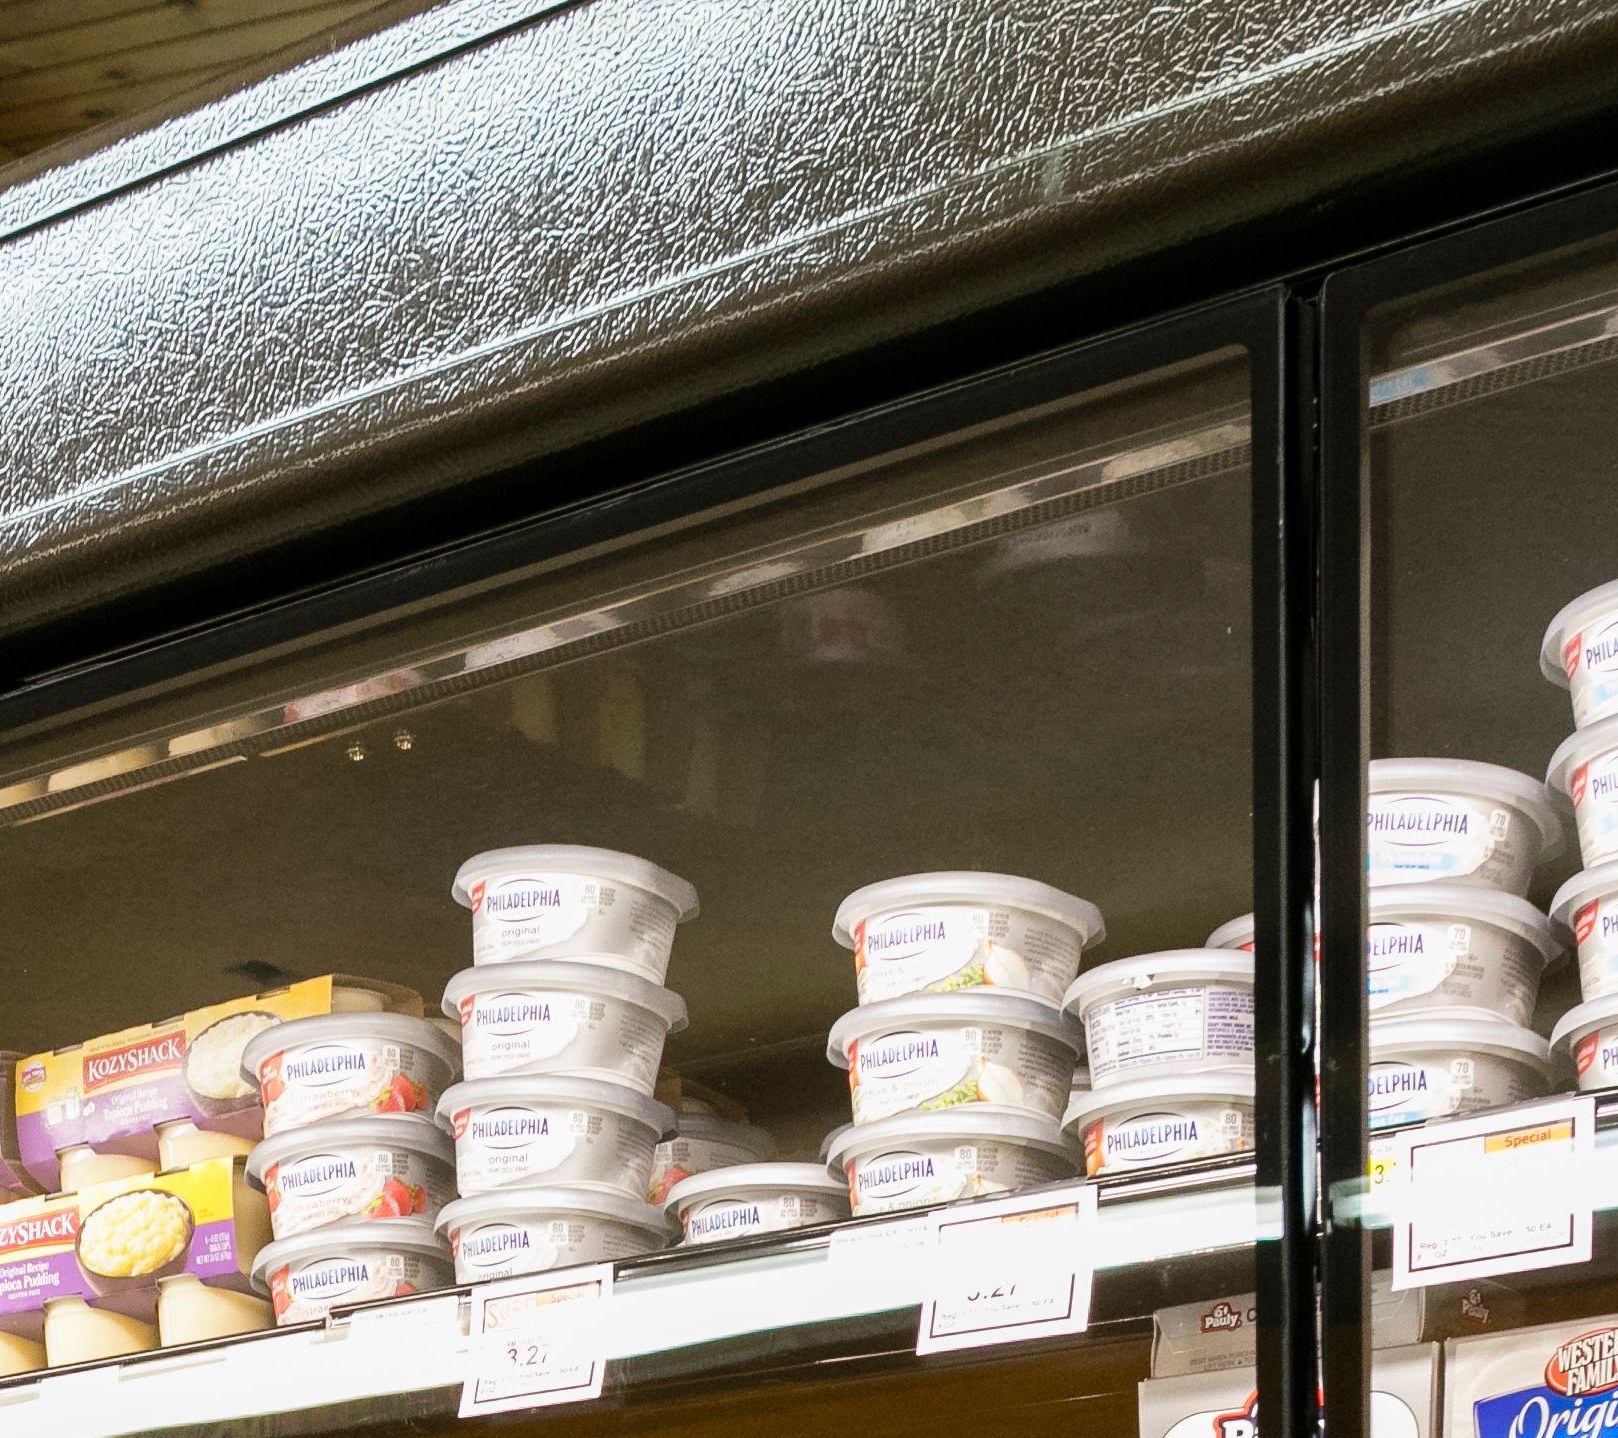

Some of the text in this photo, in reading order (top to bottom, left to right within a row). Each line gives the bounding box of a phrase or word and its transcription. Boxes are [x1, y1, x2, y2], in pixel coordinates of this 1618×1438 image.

[486, 888, 561, 911] PHILADELPHIA
[86, 1038, 182, 1080] KOZYSHACK
[1107, 1120, 1198, 1154] PHILADELPHIA
[1204, 1313, 1239, 1330] Pauly
